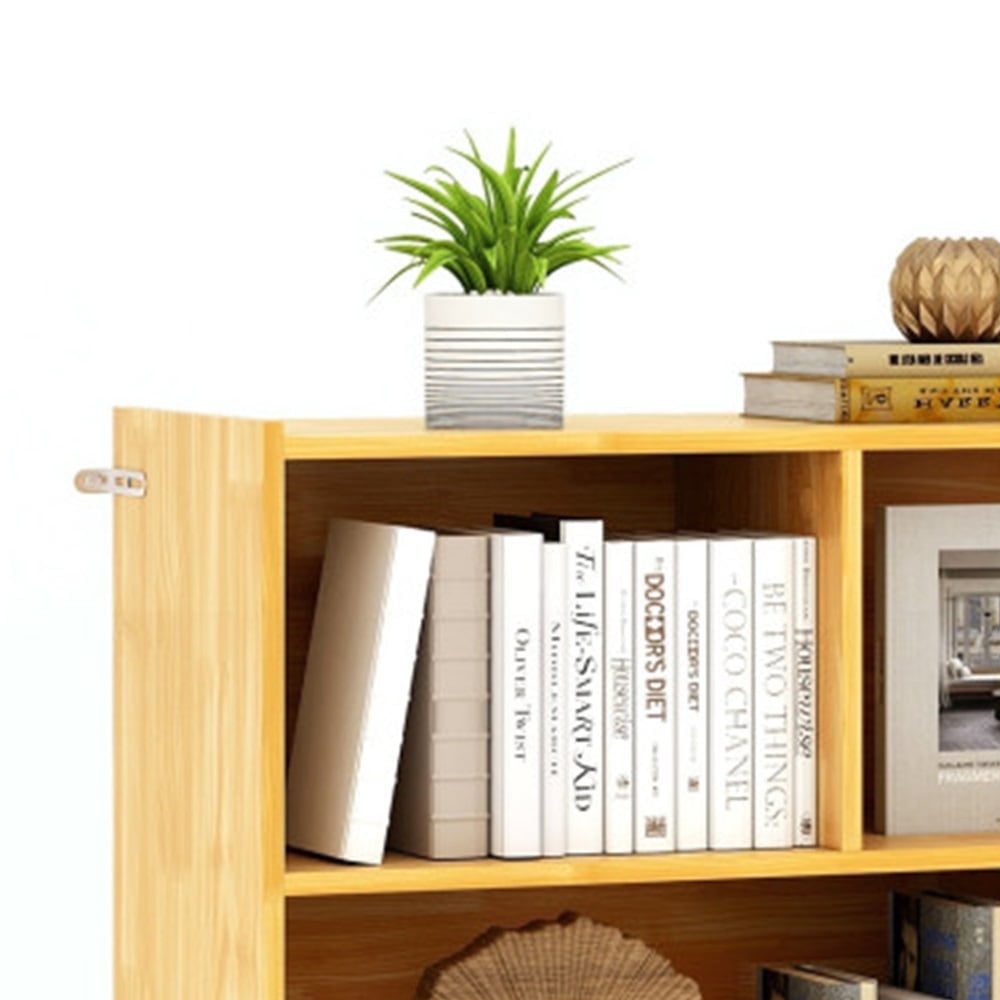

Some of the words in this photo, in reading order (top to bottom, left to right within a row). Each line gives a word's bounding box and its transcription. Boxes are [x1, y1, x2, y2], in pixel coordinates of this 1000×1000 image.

[762, 629, 787, 698] TWO
[646, 678, 667, 724] DIET
[724, 686, 749, 810] CHANEL
